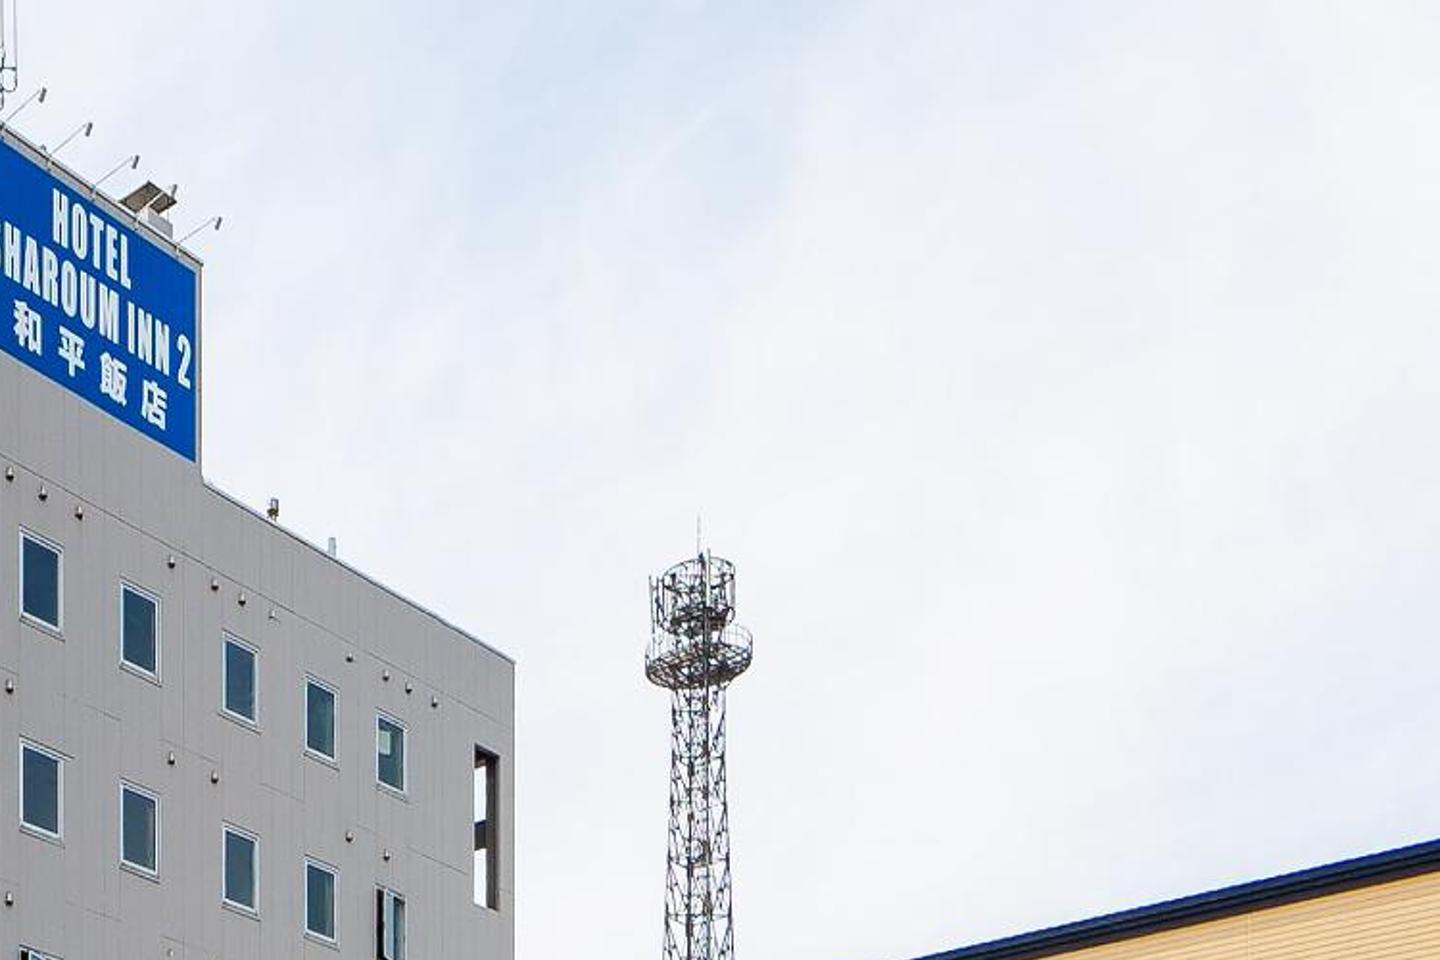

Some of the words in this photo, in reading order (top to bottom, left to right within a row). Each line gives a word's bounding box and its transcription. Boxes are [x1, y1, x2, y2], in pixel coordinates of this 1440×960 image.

[51, 187, 132, 290] HOTEL
[12, 299, 168, 431] 和平飯店
[127, 301, 171, 377] INN
[176, 333, 192, 390] 2
